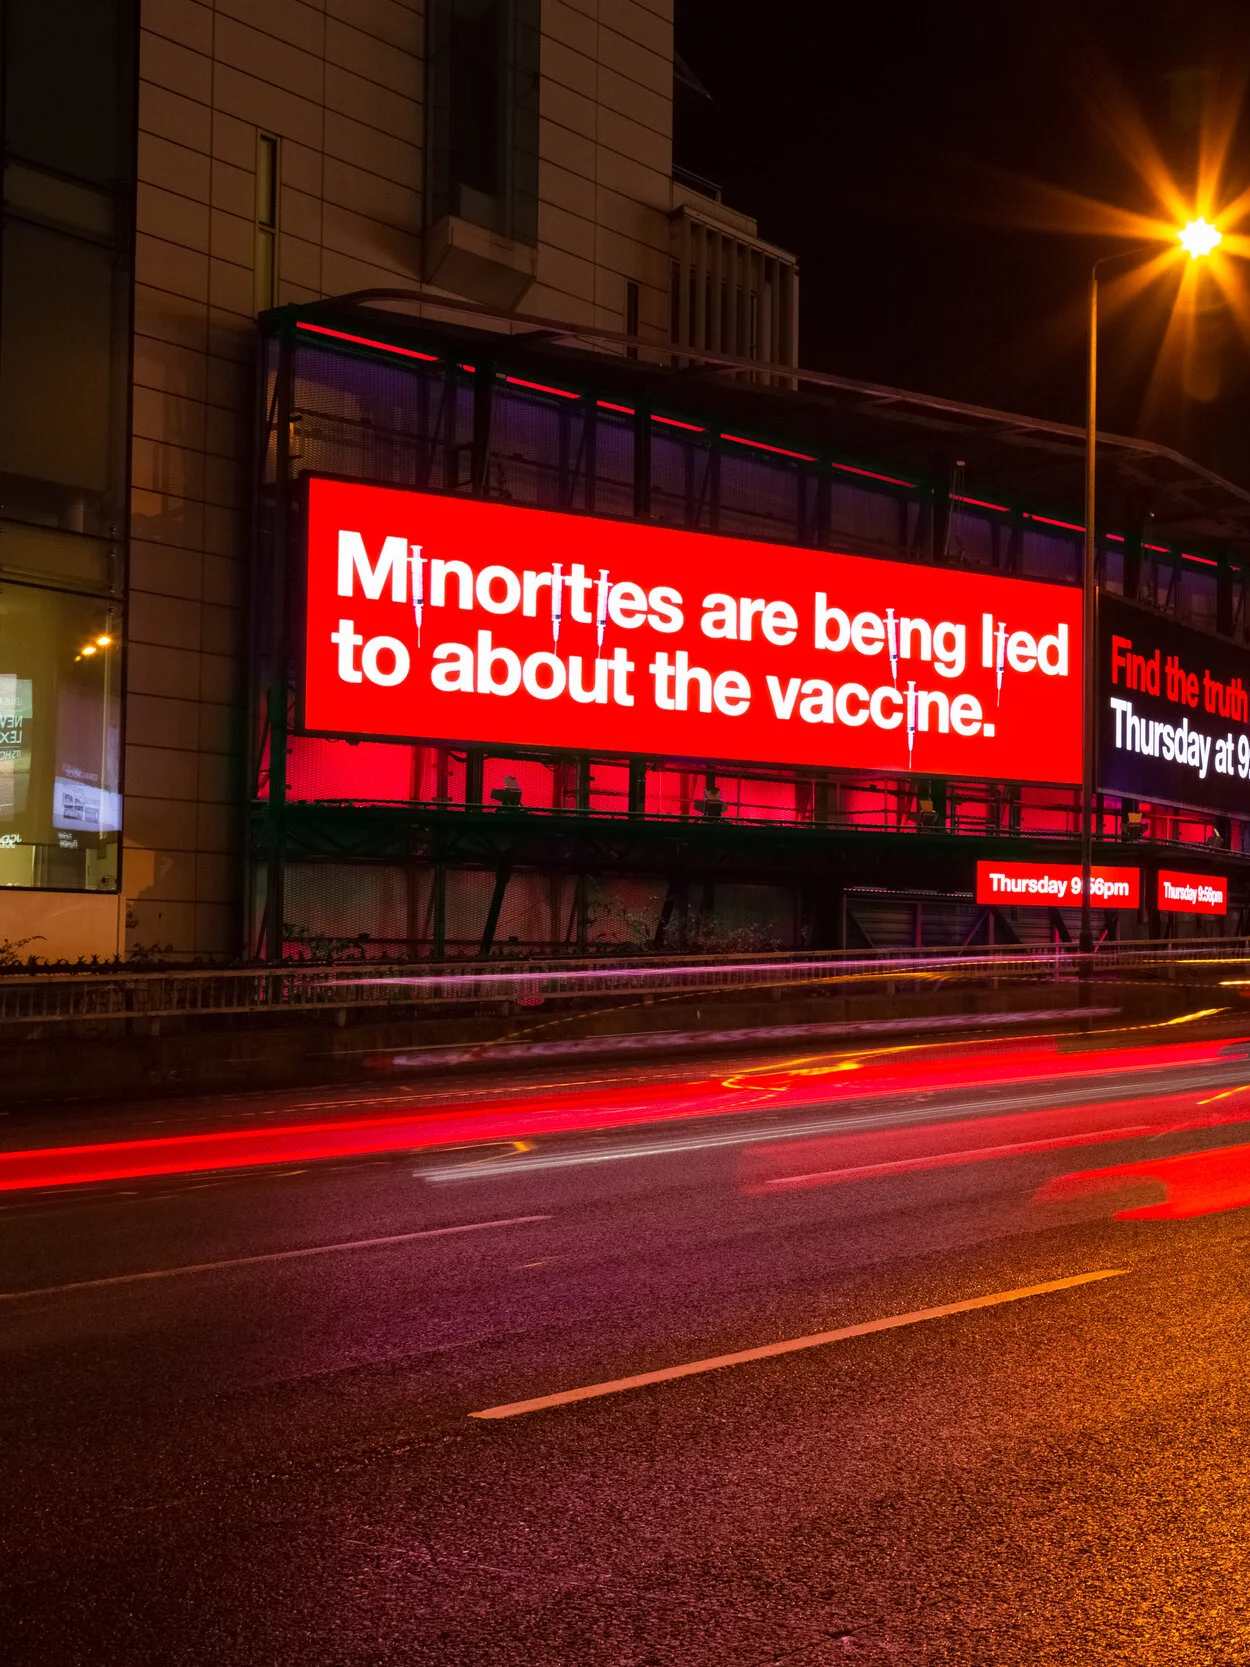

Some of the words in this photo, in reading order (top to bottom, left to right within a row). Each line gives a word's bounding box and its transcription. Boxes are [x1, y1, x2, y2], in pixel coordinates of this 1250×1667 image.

[336, 530, 684, 636] Minorities
[701, 593, 798, 645] are
[812, 592, 966, 680] being
[982, 613, 1068, 680] lied
[331, 619, 410, 686] to
[431, 628, 634, 706] about
[649, 651, 751, 716] the
[766, 674, 995, 740] vaccine.
[1111, 635, 1160, 698] Find
[1165, 656, 1199, 707] the
[1203, 670, 1248, 723] truth
[1111, 697, 1211, 778] Thursday
[1215, 733, 1234, 775] at
[989, 873, 1067, 897] Thursday
[1164, 882, 1198, 904] Thursday
